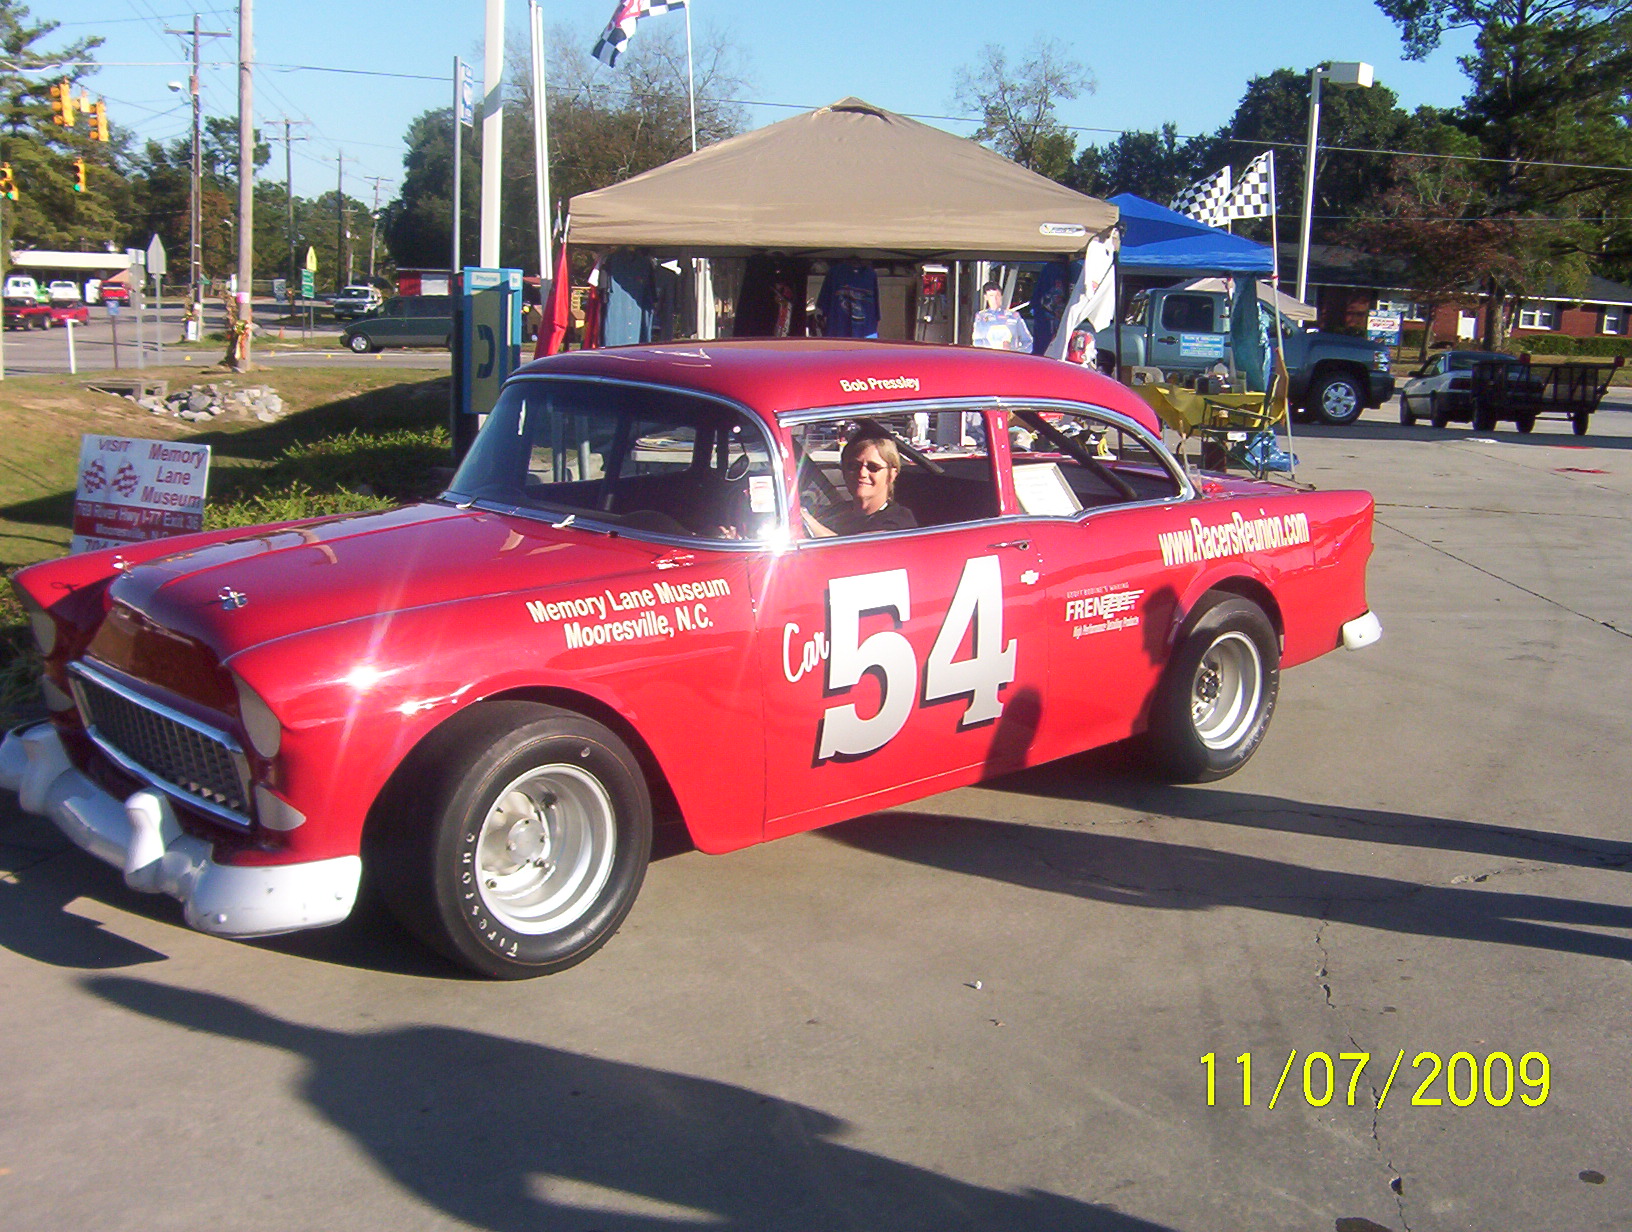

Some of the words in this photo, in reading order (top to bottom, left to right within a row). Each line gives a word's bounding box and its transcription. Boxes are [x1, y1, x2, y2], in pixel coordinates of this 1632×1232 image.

[840, 378, 868, 392] Bob
[867, 376, 920, 391] Pressley
[99, 439, 132, 451] VISIT
[148, 443, 205, 469] Memory
[156, 466, 191, 485] Lane
[141, 486, 201, 508] Museum
[1158, 508, 1310, 567] www.RacersReunion.com
[525, 595, 607, 623] Memory
[604, 588, 657, 611] Lane
[652, 577, 732, 604] Museum
[563, 610, 675, 650] Mooresville,
[674, 603, 714, 632] N.C.
[783, 622, 830, 682] Car
[814, 554, 1018, 765] 54
